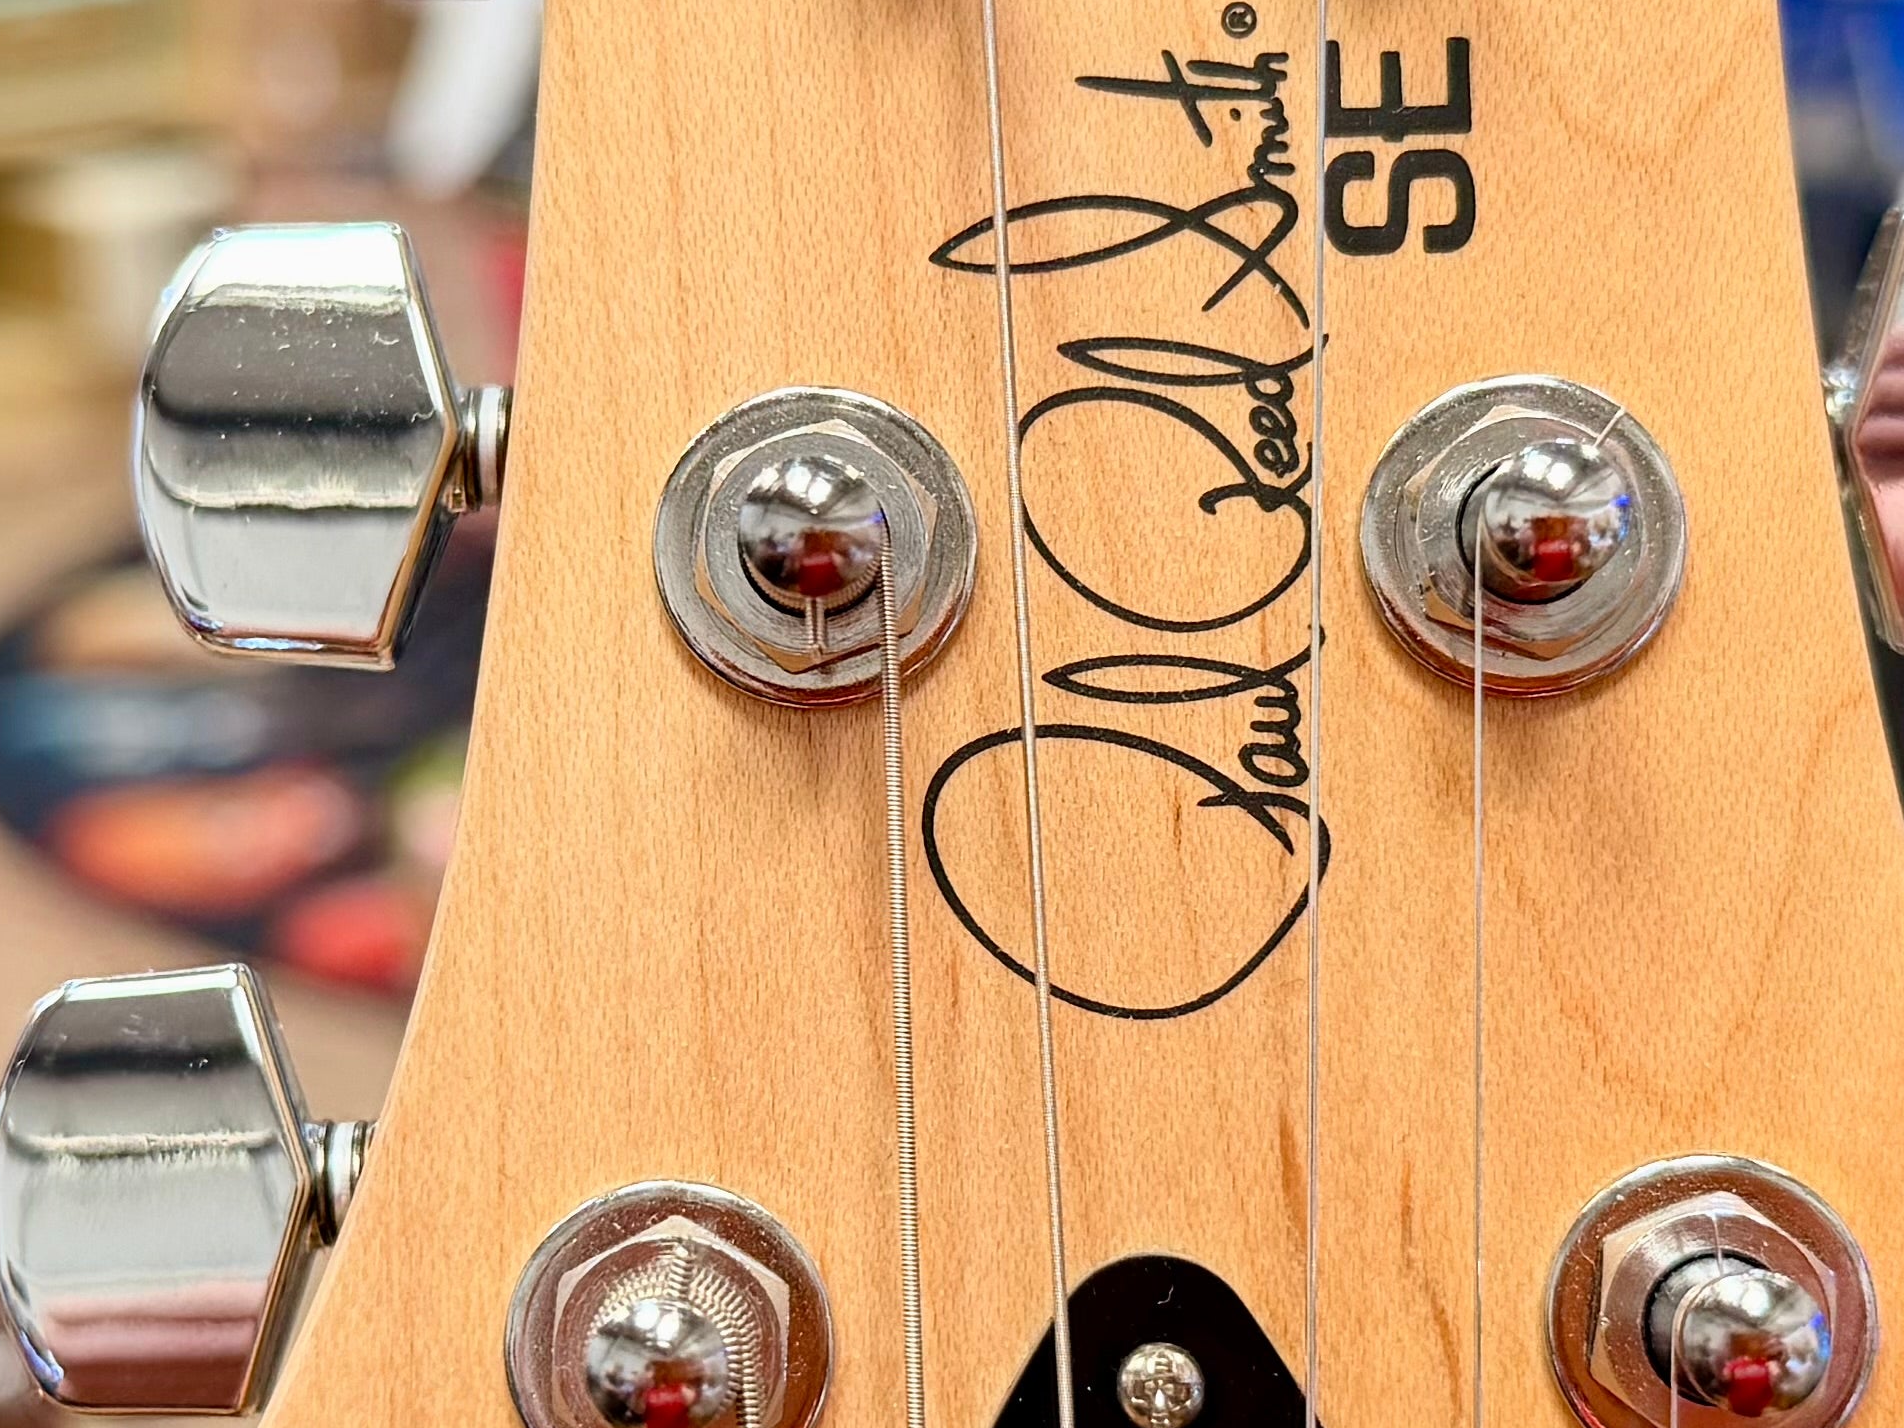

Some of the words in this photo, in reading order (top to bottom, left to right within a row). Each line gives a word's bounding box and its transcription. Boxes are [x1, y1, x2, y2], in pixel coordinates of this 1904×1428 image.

[1322, 35, 1474, 258] SE
[1018, 332, 1330, 634] Reed
[921, 627, 1331, 1022] Paul
